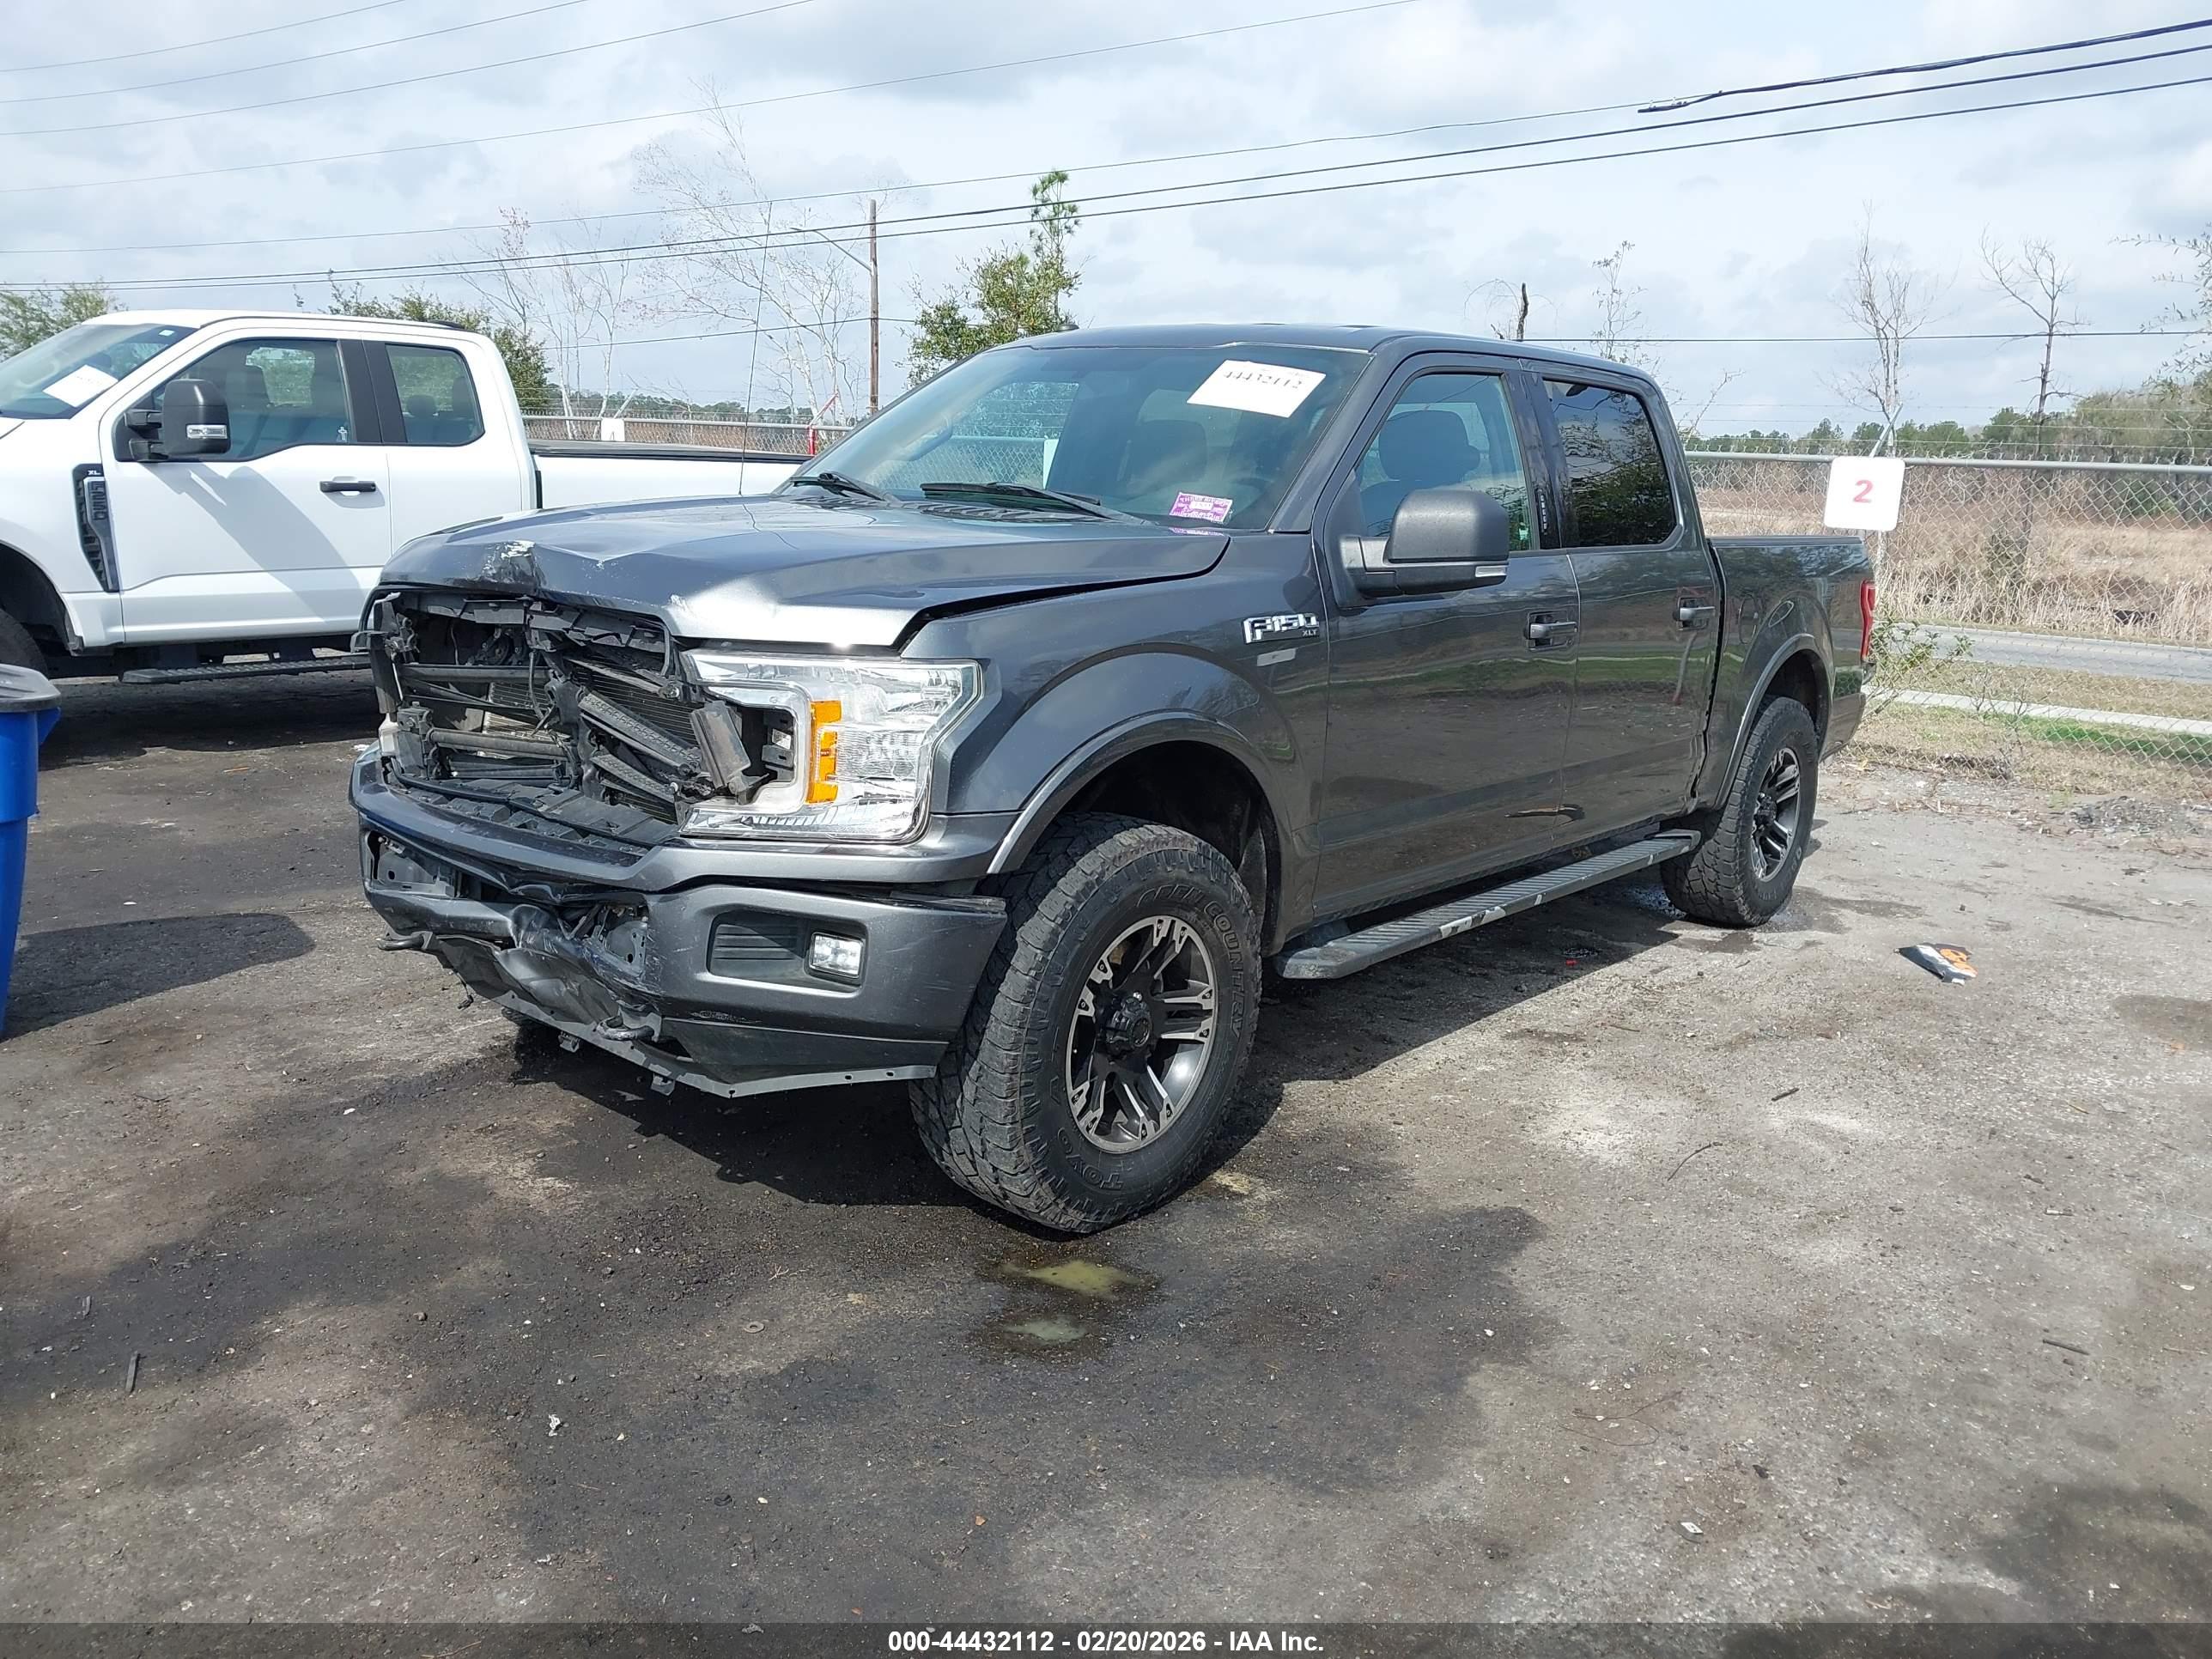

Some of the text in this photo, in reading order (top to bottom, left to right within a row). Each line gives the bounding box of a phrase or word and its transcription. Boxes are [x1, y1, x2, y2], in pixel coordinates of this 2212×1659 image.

[1853, 479, 1874, 503] 2
[1302, 629, 1319, 637] XLT
[1204, 901, 1245, 1038] COUNTRY
[1057, 1127, 1124, 1191] TOYO
